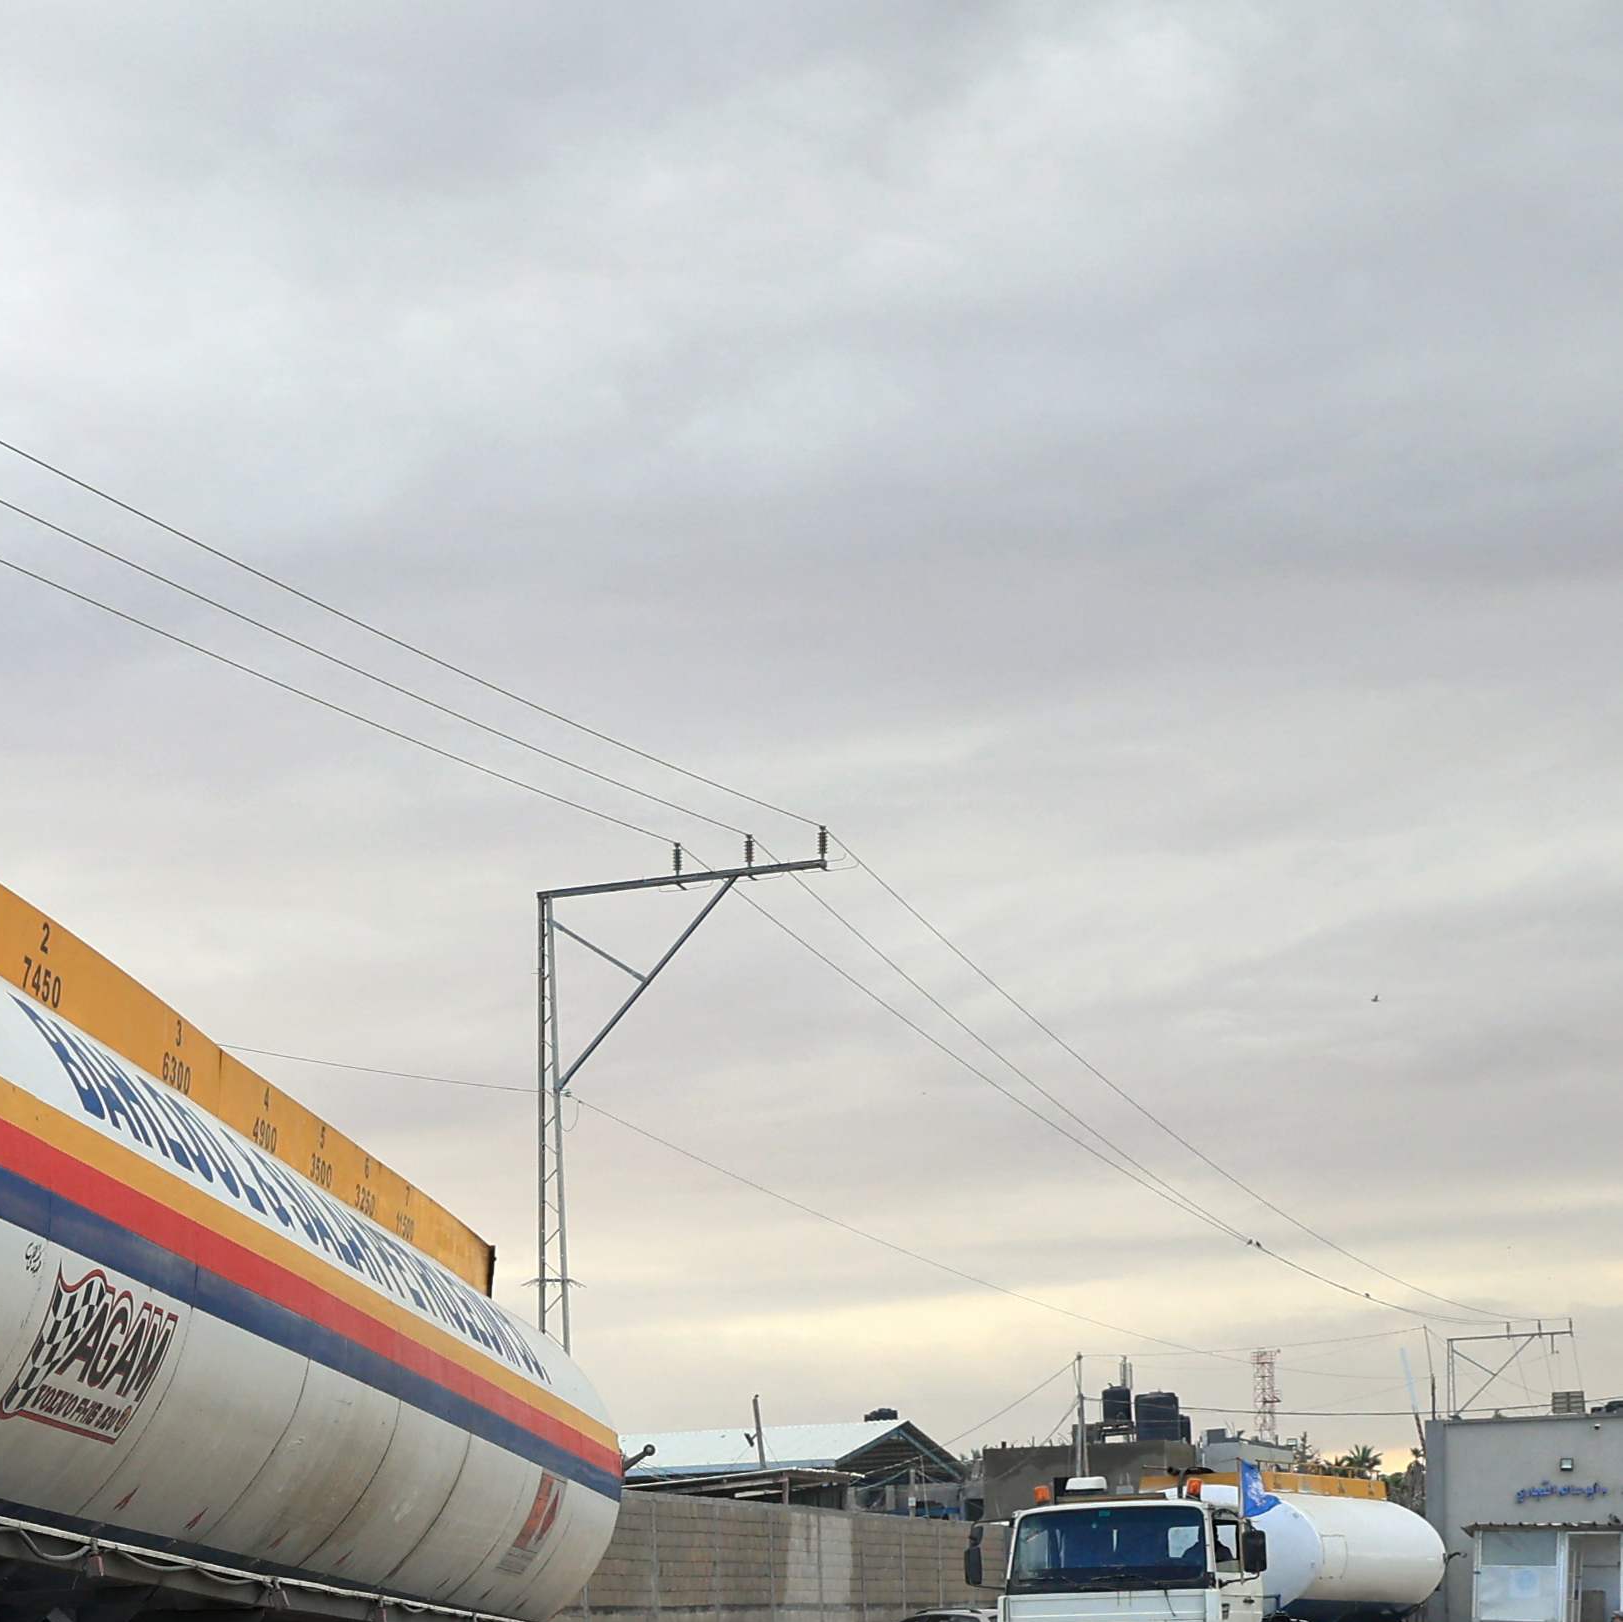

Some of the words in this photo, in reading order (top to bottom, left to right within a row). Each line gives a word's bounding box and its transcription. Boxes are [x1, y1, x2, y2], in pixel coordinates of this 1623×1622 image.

[39, 922, 51, 955] 2
[21, 956, 62, 1010] 7450
[174, 1019, 183, 1048] 3
[161, 1051, 192, 1096] 6300
[262, 1087, 271, 1112] 4
[251, 1118, 278, 1155] 4900
[55, 1300, 172, 1403] AGAM
